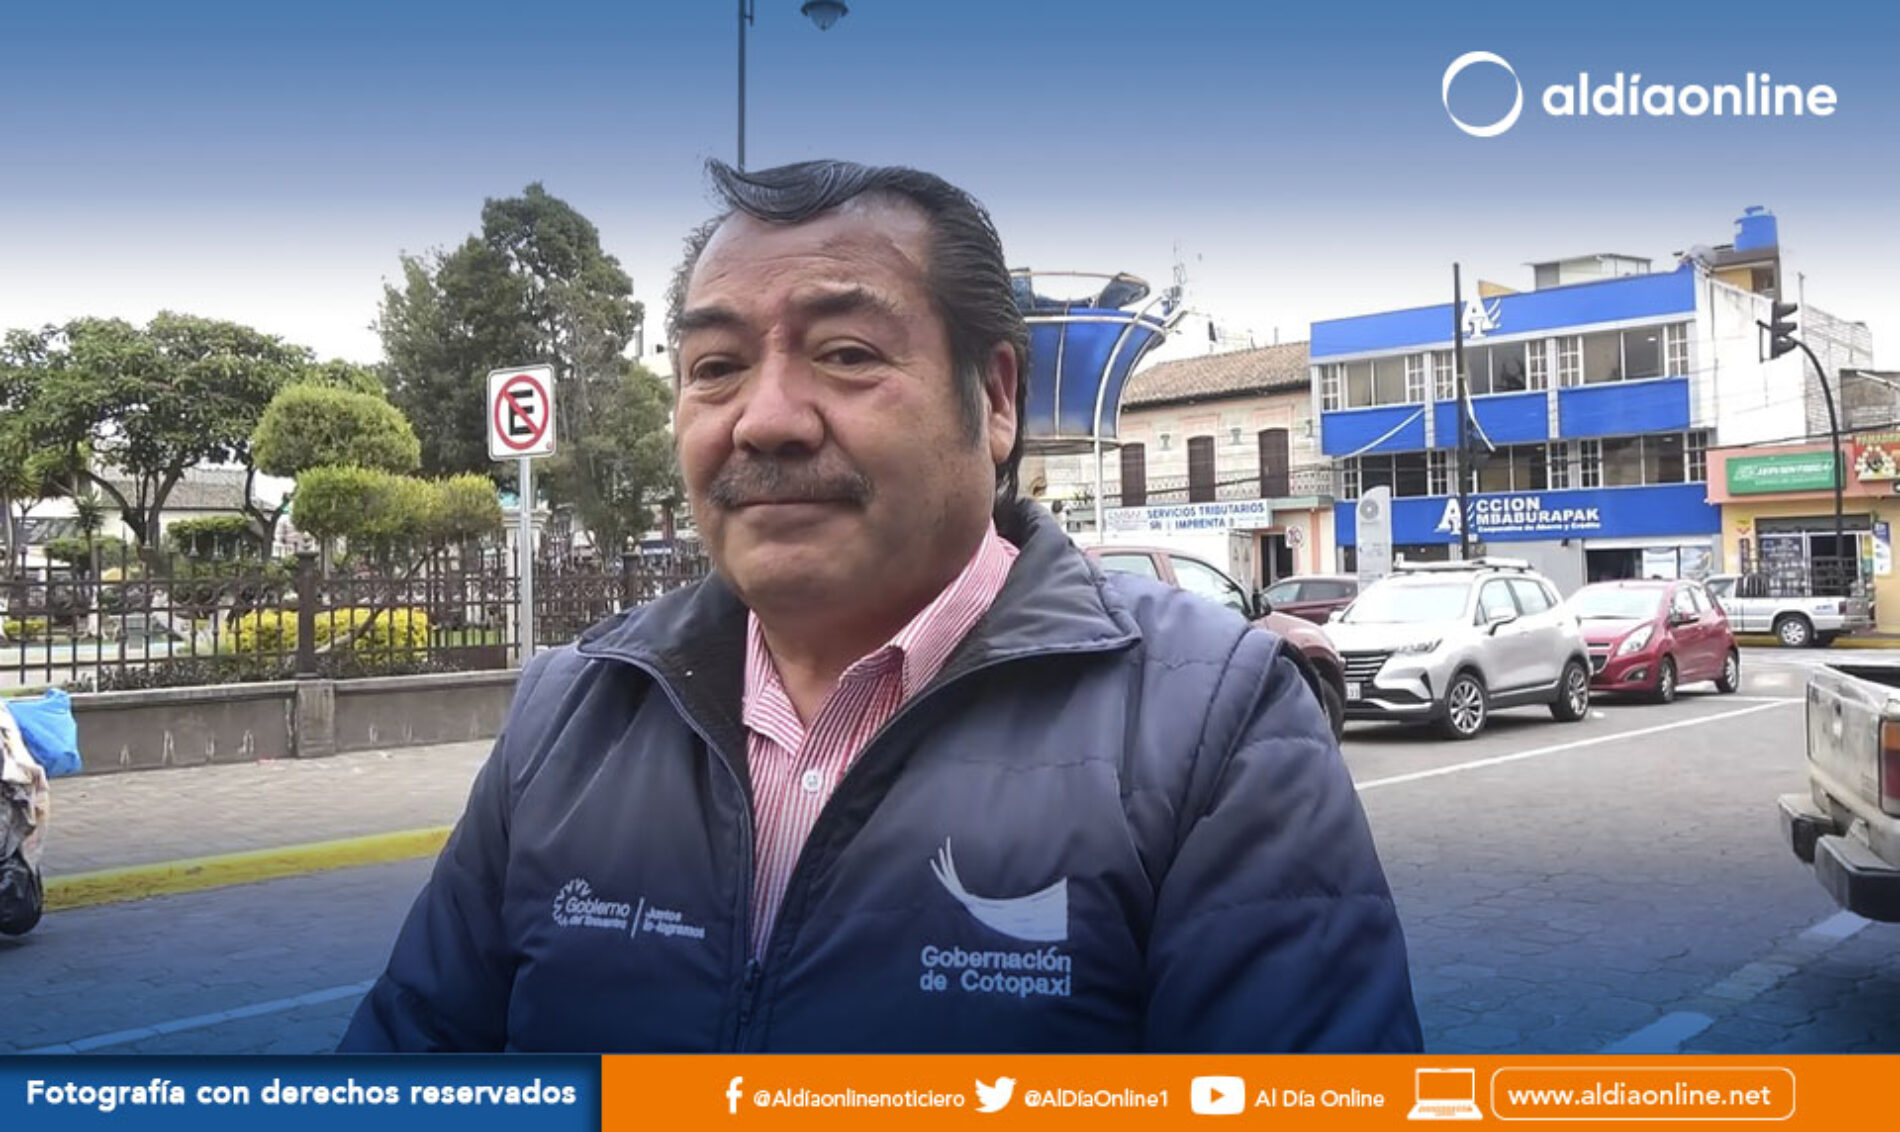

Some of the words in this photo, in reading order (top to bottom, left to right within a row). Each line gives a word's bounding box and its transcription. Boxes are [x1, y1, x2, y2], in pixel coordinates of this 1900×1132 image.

[508, 388, 535, 436] E
[1147, 506, 1196, 519] SERVICIOS
[1199, 502, 1265, 516] TRIBUTARIOS
[1175, 518, 1226, 530] IMPRENTA
[565, 896, 631, 917] Gobierno
[920, 945, 1072, 973] Gobernación
[920, 969, 947, 991] de
[960, 969, 1072, 999] Cotopaxi
